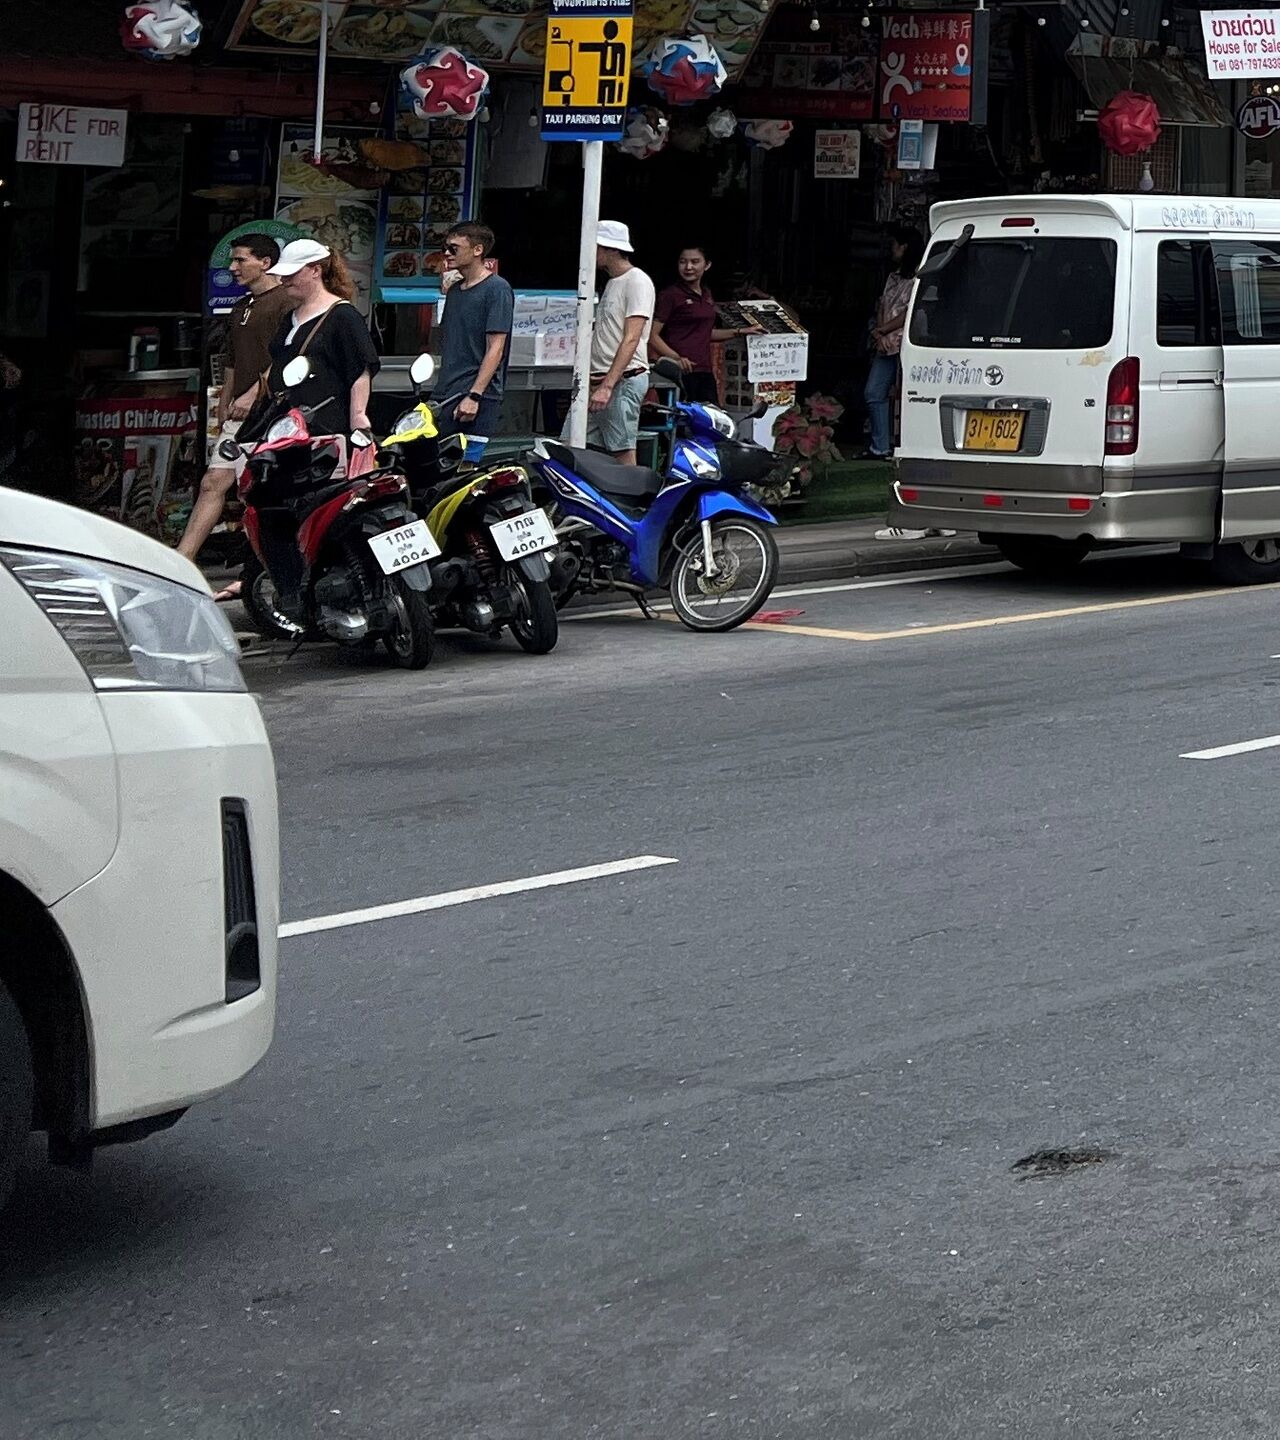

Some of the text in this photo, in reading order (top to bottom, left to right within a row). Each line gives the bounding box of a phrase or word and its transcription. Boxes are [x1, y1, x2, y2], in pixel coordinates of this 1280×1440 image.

[881, 16, 919, 39] Vech
[1211, 13, 1276, 37] ขายด่วน
[1208, 40, 1240, 55] House
[1243, 39, 1258, 54] for
[1212, 60, 1227, 72] Tel
[27, 105, 120, 137] BIKE FOR
[545, 113, 623, 125] TAXI PARKING ONLY
[1240, 105, 1280, 130] AFL
[24, 139, 74, 162] RENT
[124, 409, 177, 429] Chicken
[968, 418, 1020, 440] 31-1602
[511, 536, 546, 556] 4007
